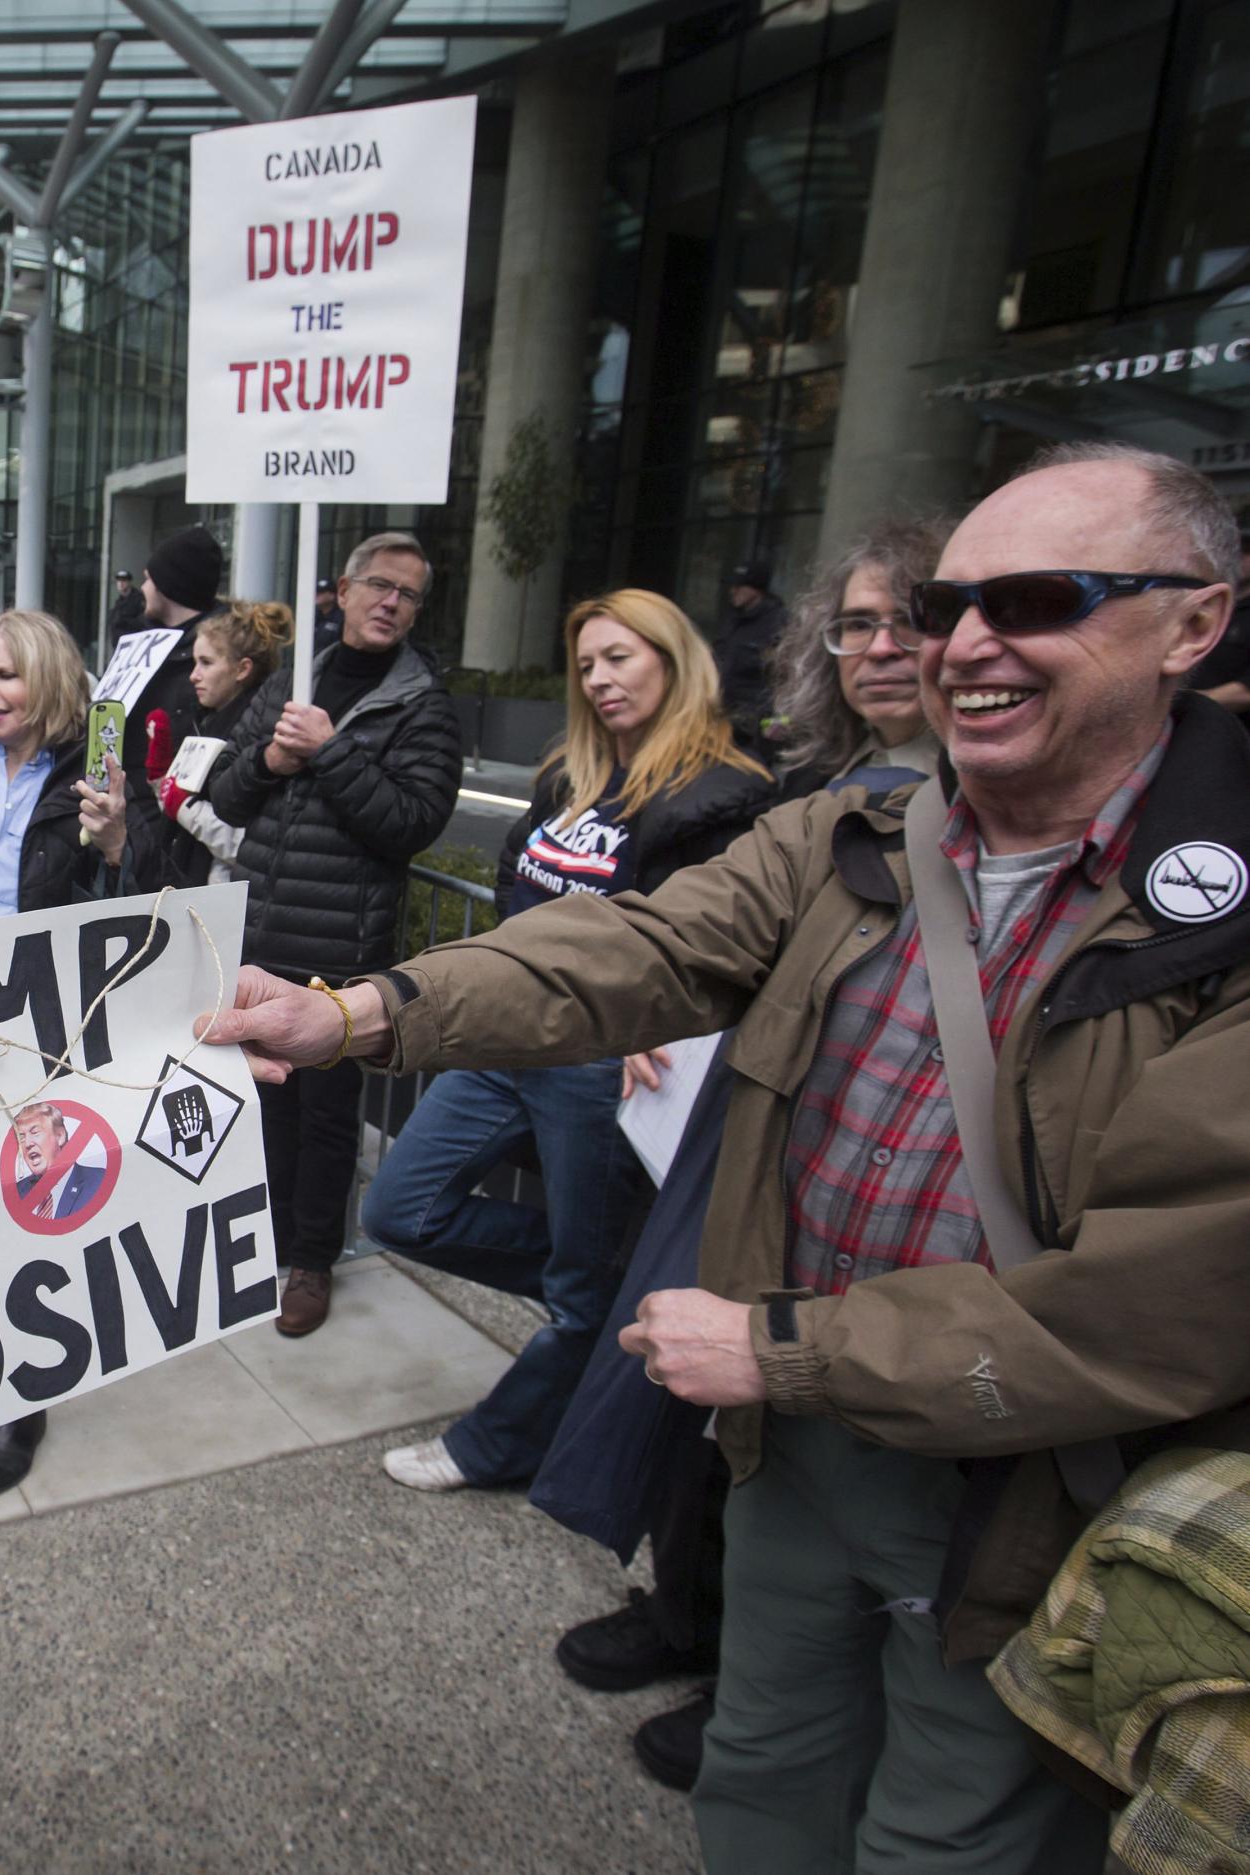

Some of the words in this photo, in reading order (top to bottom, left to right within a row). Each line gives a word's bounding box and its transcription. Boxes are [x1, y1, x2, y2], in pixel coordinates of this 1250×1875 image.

[265, 141, 382, 181] CANADA
[247, 212, 399, 281] DUMP
[291, 302, 344, 332] THE
[229, 354, 410, 414] TRUMP
[265, 449, 356, 476] BRAND
[517, 852, 564, 894] Prison
